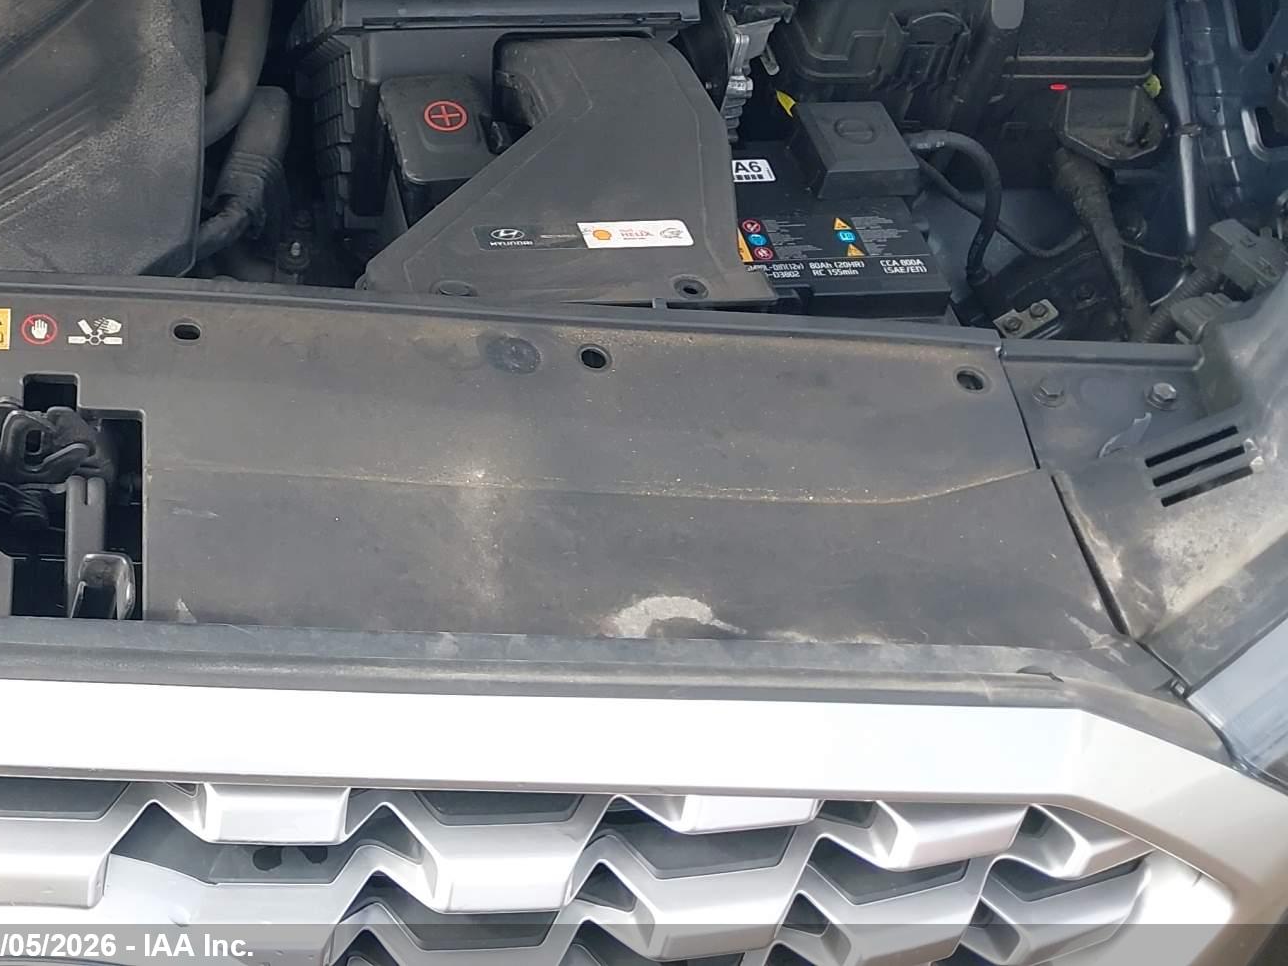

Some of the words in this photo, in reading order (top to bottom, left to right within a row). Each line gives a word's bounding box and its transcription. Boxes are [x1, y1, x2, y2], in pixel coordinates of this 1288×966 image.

[735, 161, 762, 173] A6
[879, 259, 900, 267] CCA
[812, 269, 826, 277] RC
